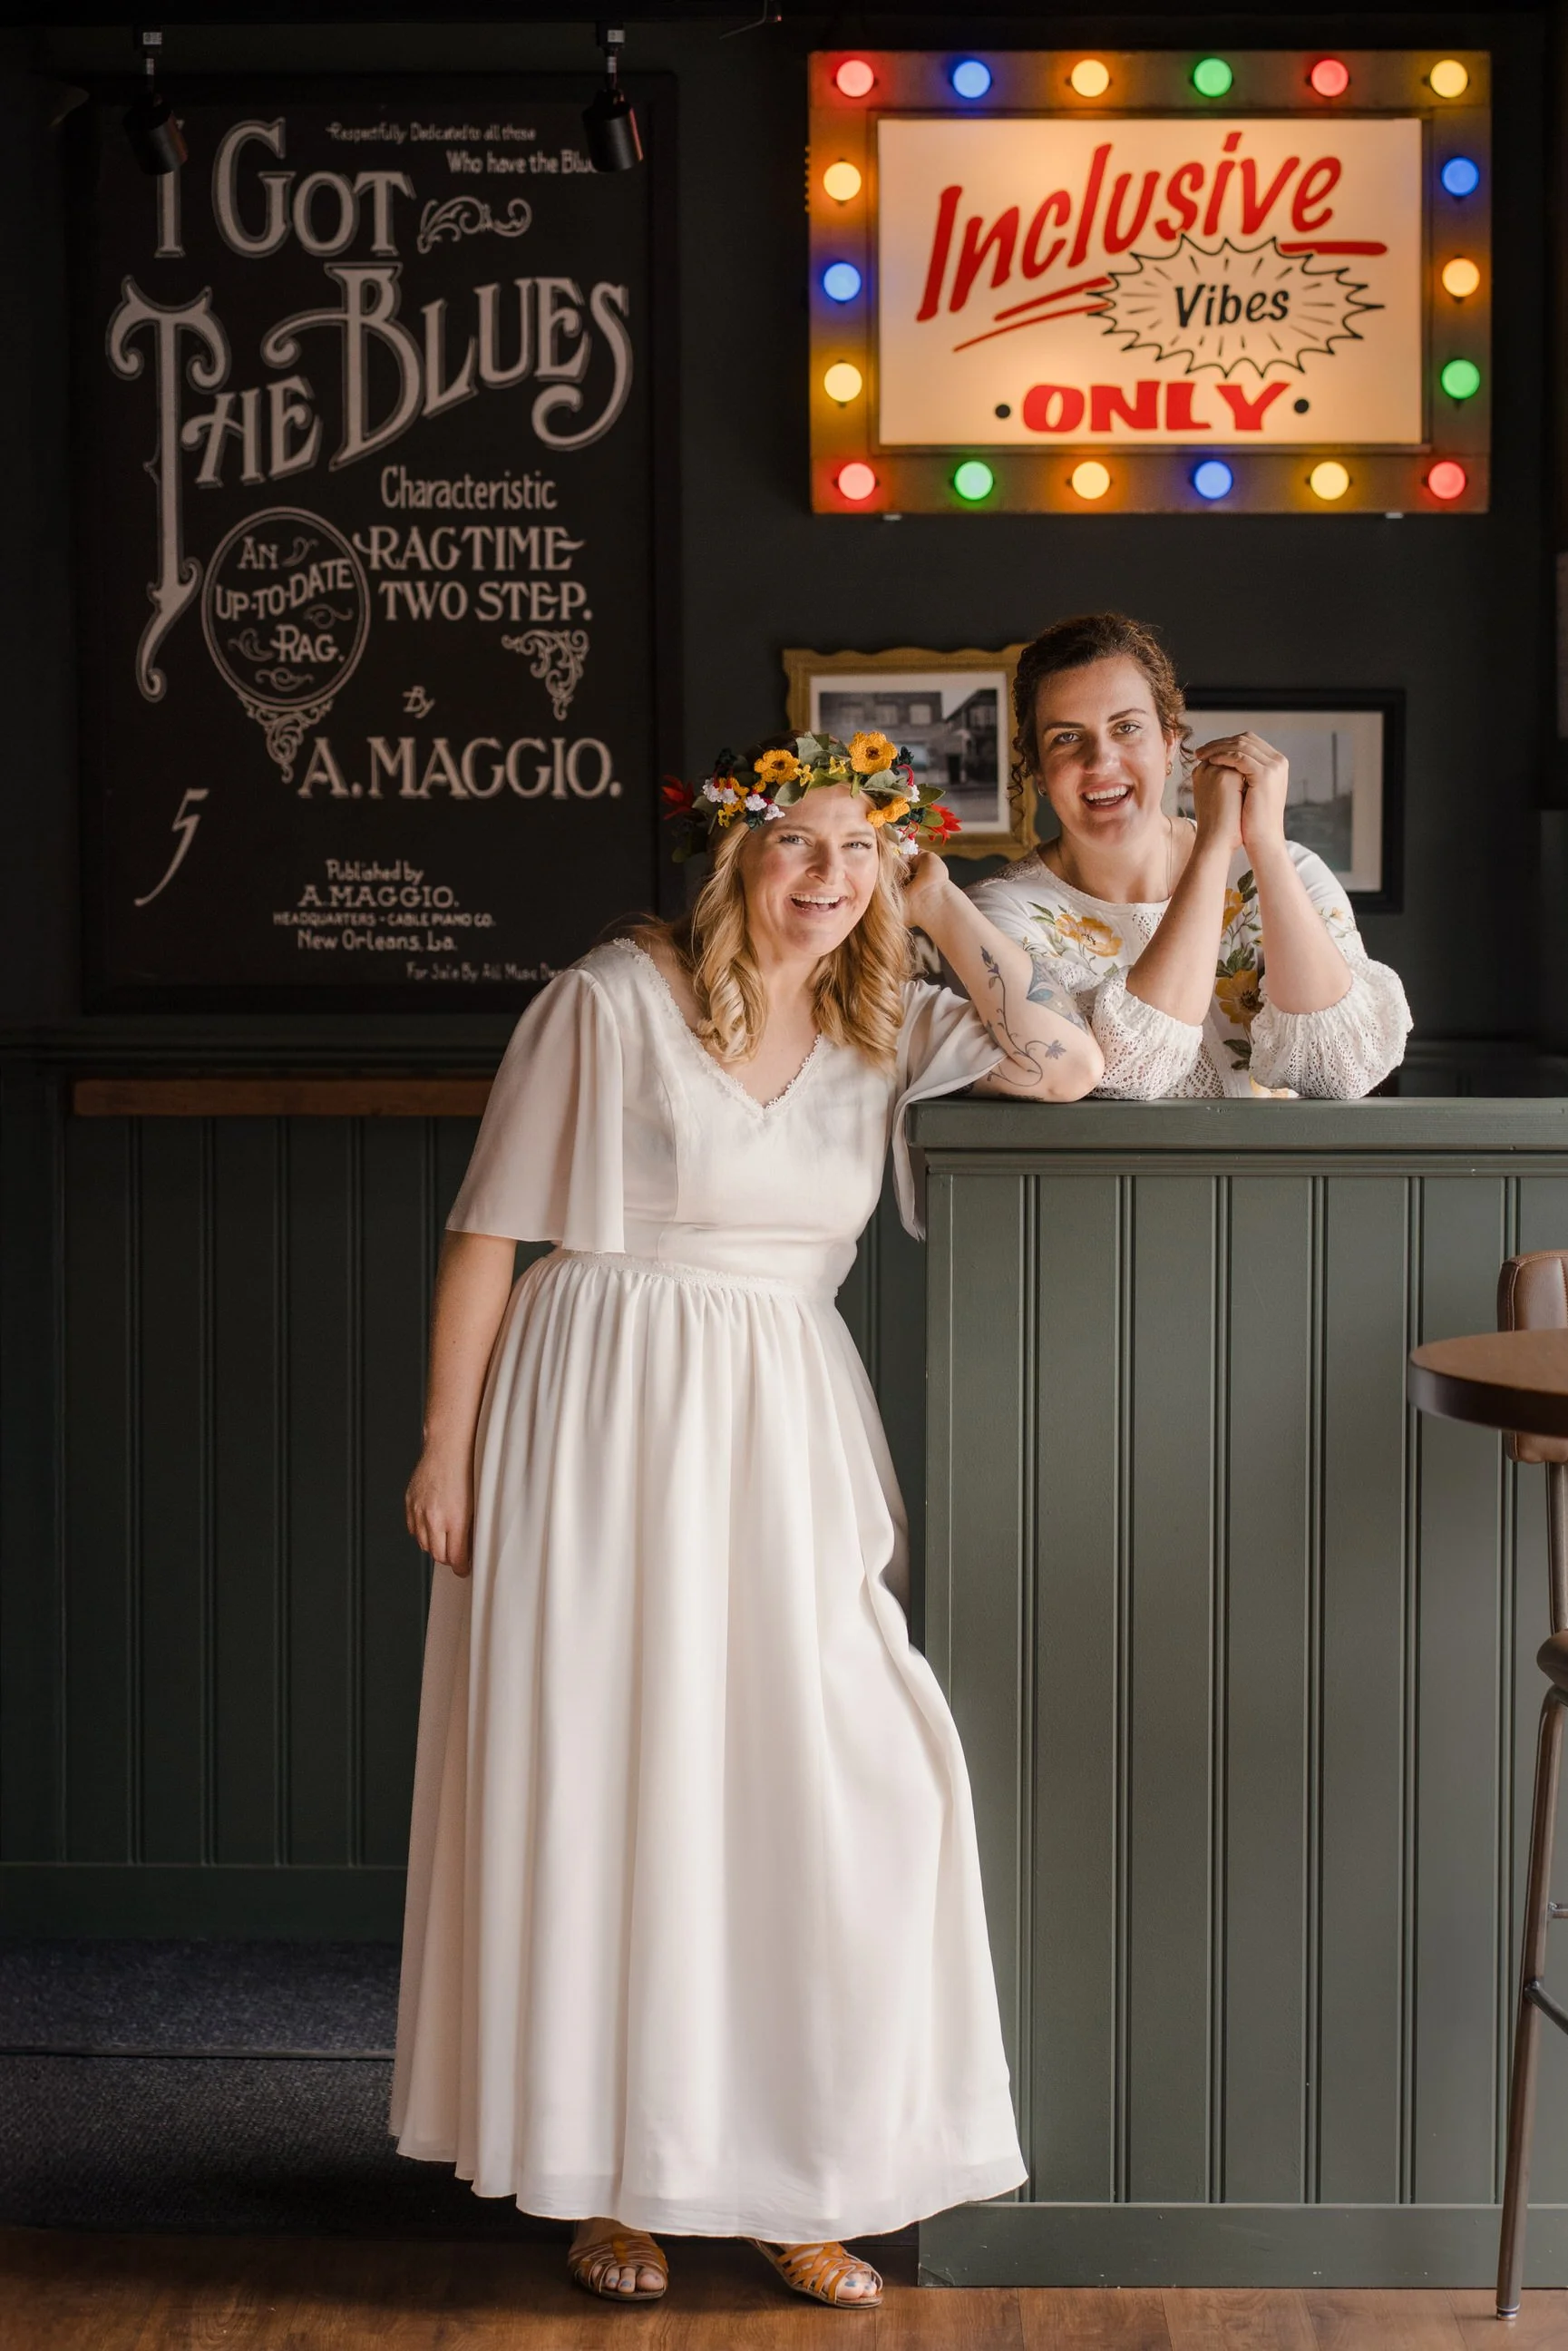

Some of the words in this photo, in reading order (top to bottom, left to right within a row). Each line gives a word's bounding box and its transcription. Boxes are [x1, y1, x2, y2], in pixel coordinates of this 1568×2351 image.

[482, 123, 501, 141] all
[446, 149, 483, 174] Who
[487, 149, 527, 174] have
[529, 150, 559, 174] the
[211, 118, 416, 259] GOT
[916, 132, 1342, 323] Inclusive
[1173, 283, 1291, 329] Vibes
[1021, 380, 1291, 433] ONLY
[105, 274, 324, 703] THE
[261, 262, 634, 471] BLUES
[381, 464, 558, 511] Characteristic
[237, 535, 279, 570] AN
[215, 559, 355, 621] UP-TO-DATE
[377, 580, 469, 622] TWO
[474, 580, 594, 622] STEP.
[269, 624, 346, 663] RAG.
[404, 686, 435, 718] By
[326, 859, 401, 883] Published
[402, 860, 424, 885] by
[273, 912, 377, 928] HEADQUARTERS
[297, 929, 339, 951] New
